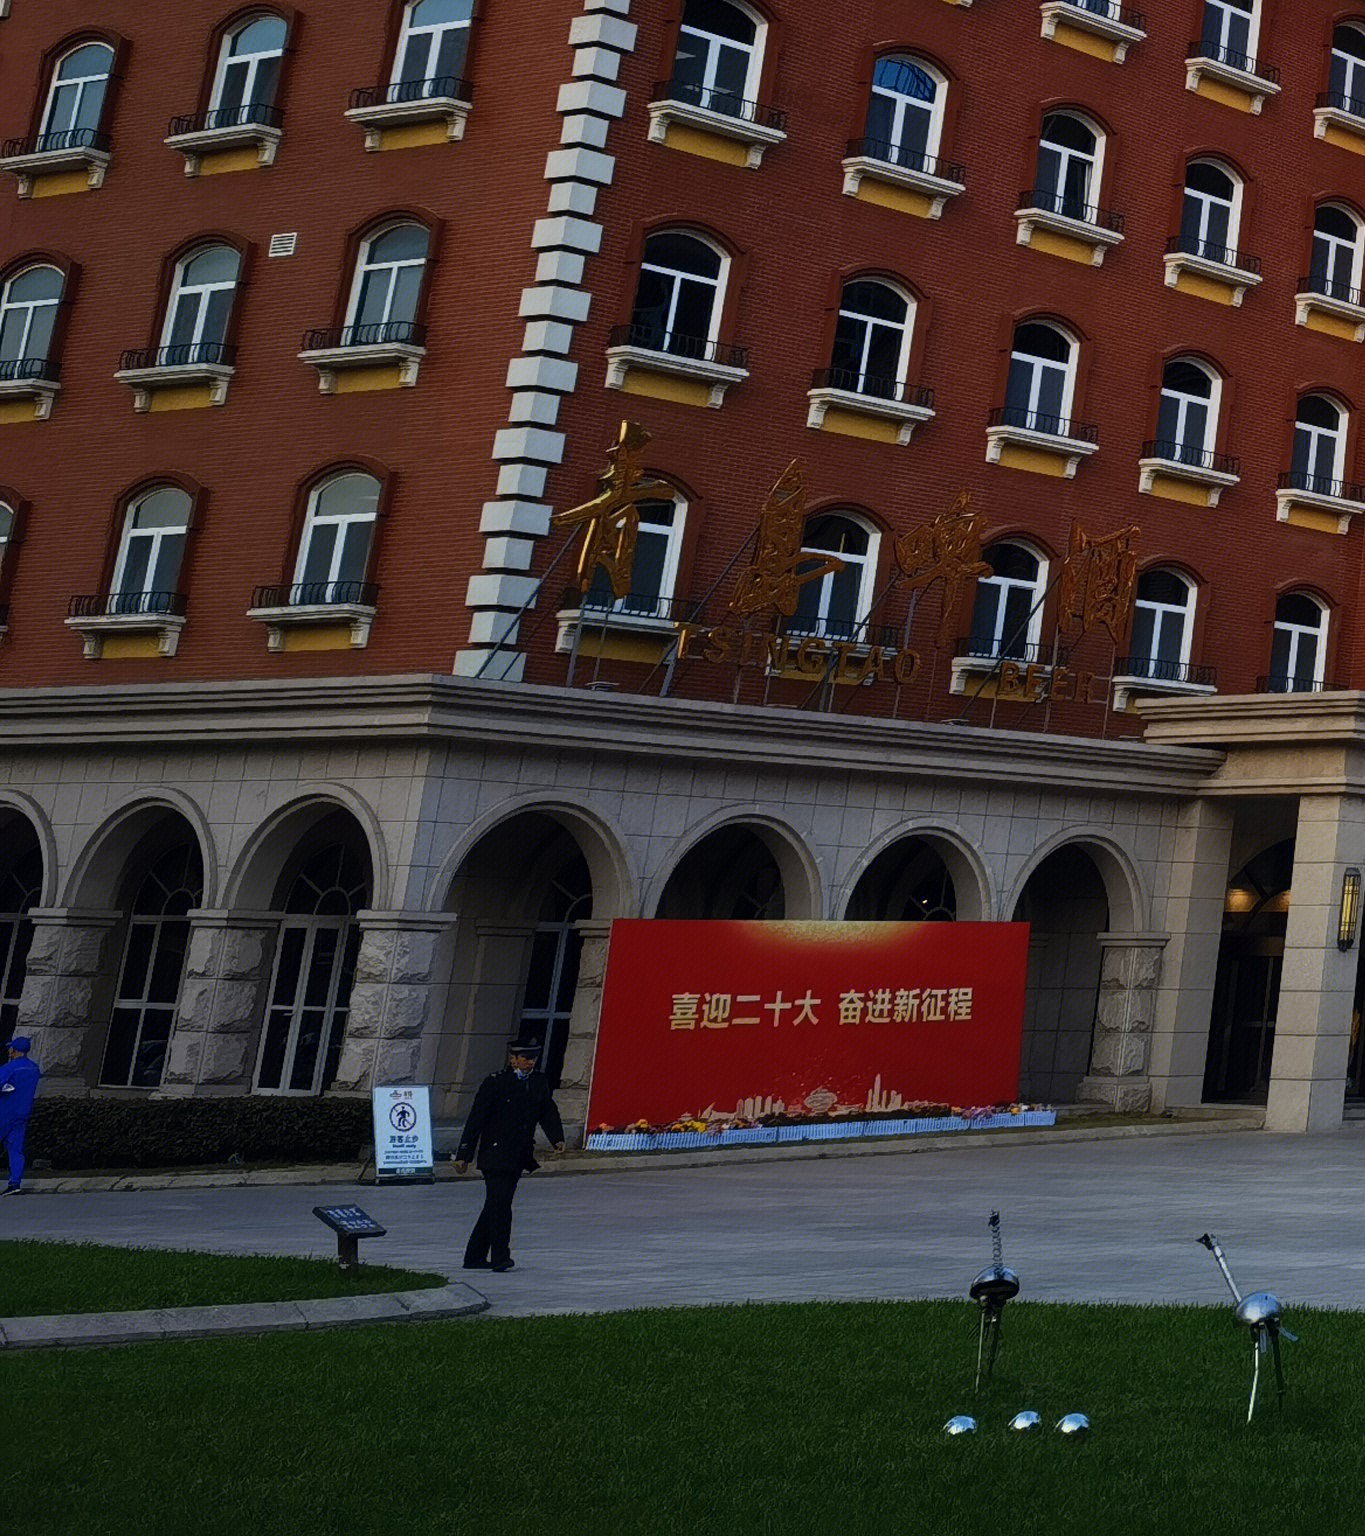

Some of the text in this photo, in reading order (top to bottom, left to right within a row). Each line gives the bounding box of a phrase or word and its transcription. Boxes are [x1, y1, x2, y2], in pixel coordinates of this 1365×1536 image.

[675, 621, 1097, 704] TSINGTAO BEER
[668, 987, 974, 1032] 喜迎二十大 奋进新征程
